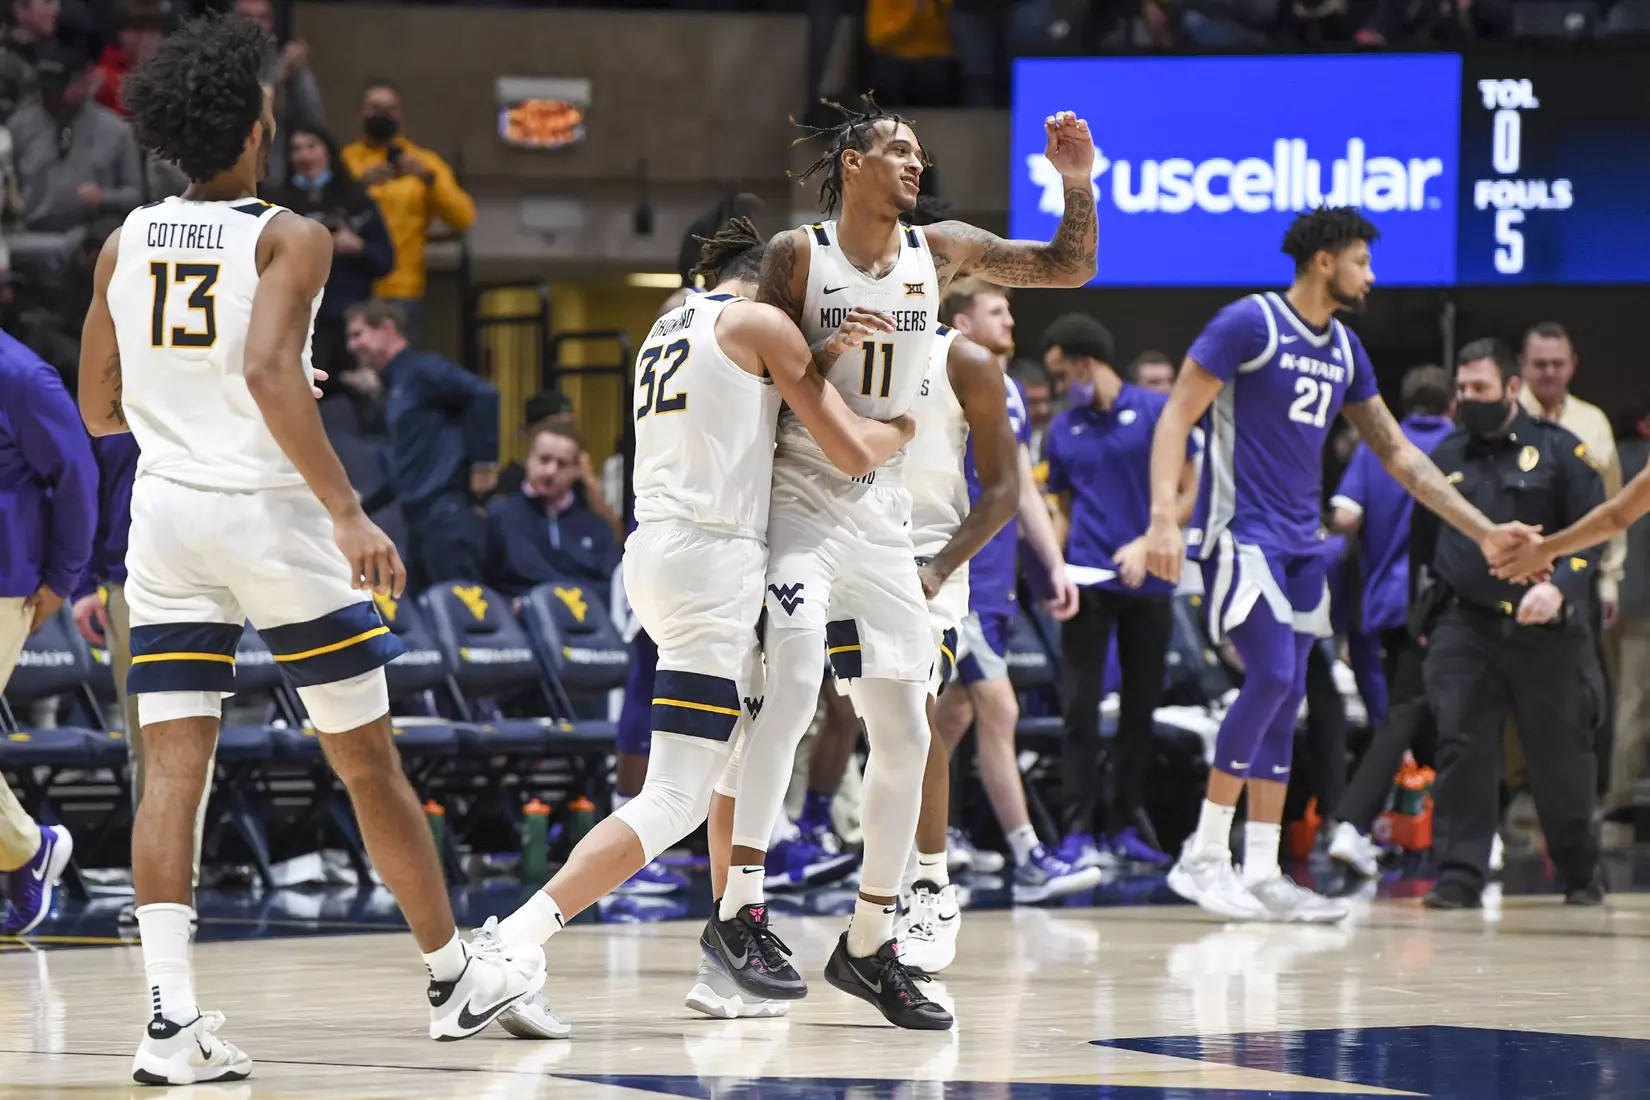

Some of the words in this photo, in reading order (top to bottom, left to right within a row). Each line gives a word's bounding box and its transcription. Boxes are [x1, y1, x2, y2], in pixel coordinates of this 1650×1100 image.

[1477, 78, 1540, 110] TOL
[1493, 109, 1520, 174] 0
[1112, 138, 1443, 213] uscellular
[1474, 178, 1574, 210] FOULS
[147, 222, 224, 249] COTTRELL
[1495, 209, 1525, 274] 5
[149, 260, 222, 349] 13
[637, 337, 690, 421] 32
[861, 340, 895, 398] 11
[1279, 352, 1345, 383] K-STATE
[1288, 376, 1333, 428] 21
